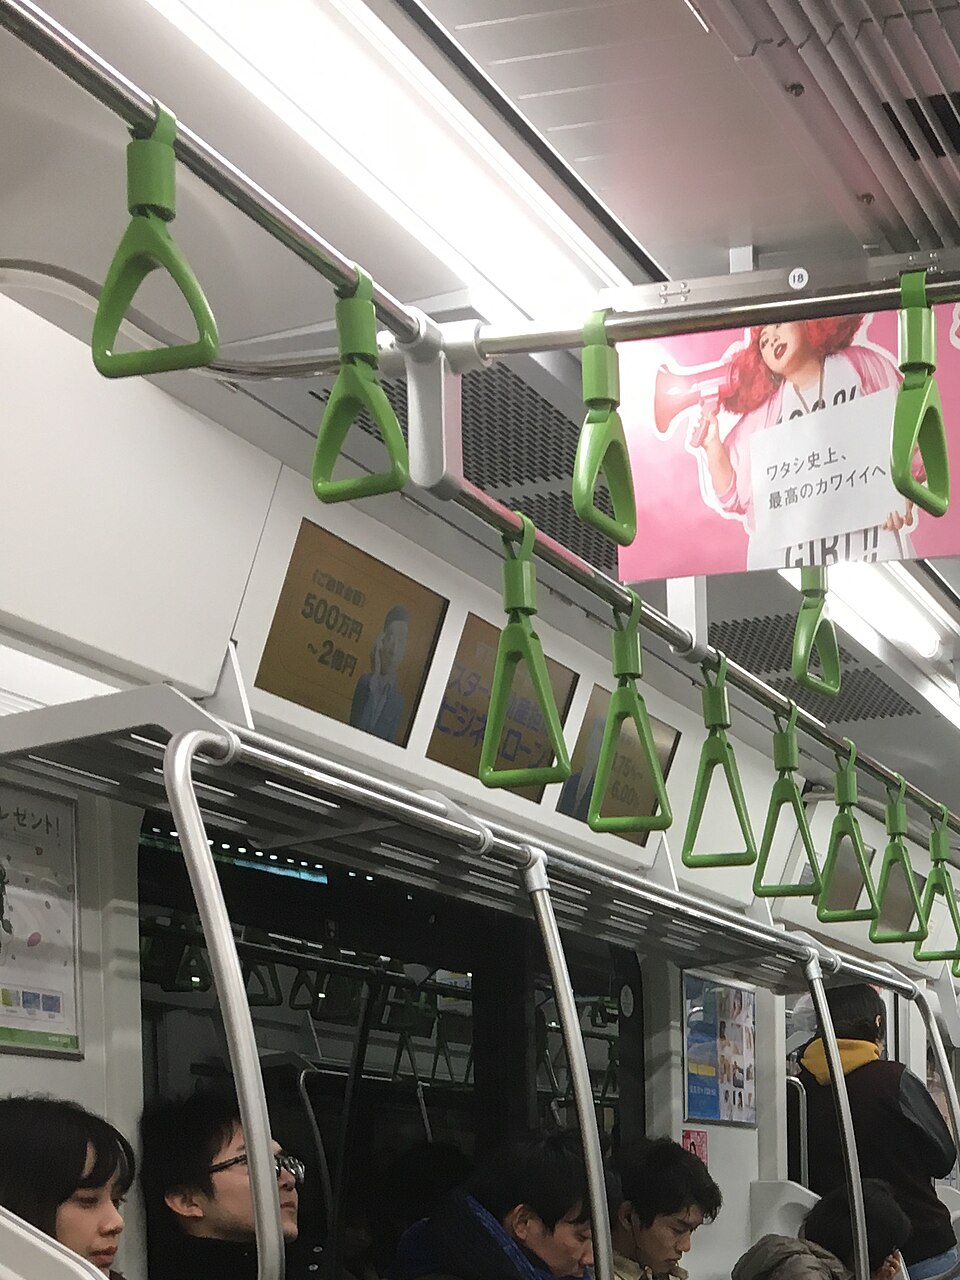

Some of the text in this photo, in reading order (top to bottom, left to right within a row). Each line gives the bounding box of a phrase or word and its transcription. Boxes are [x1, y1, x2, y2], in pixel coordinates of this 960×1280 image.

[792, 273, 804, 284] 18
[766, 447, 847, 482] ワタシ史上、
[768, 465, 887, 510] 最高のカワイイへ
[301, 591, 364, 643] 500万円
